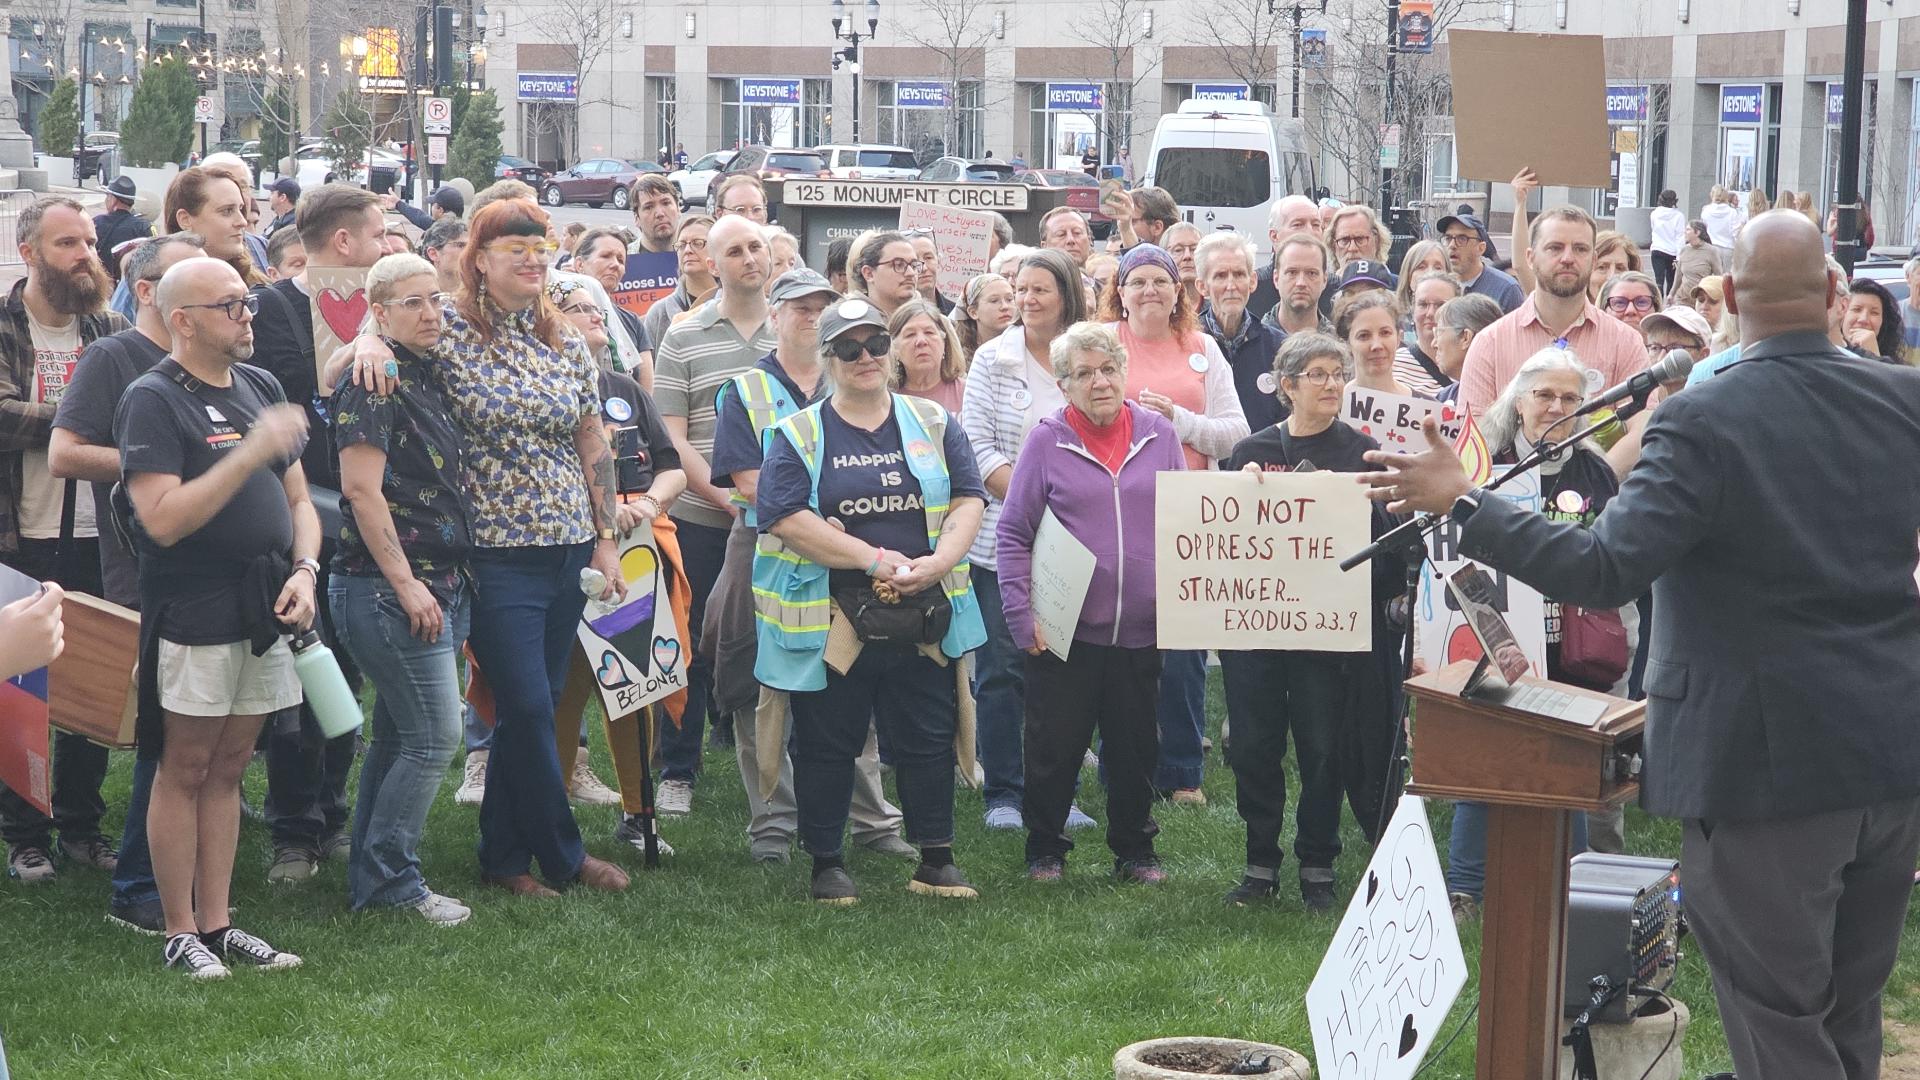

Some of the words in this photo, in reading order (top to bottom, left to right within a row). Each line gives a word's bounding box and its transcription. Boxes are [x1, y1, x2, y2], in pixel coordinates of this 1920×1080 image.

[520, 81, 566, 92] KEYSTONE
[744, 85, 789, 97] KEYSTONE
[899, 88, 943, 100] KEYSTONE
[1050, 90, 1092, 103] KEYSTONE
[1723, 95, 1756, 113] KEYSTONE
[1829, 95, 1844, 113] KEYS
[796, 185, 824, 201] 125
[834, 186, 939, 204] MONUMENT
[949, 189, 1015, 206] CIRCLE
[826, 227, 864, 237] CHRIST
[1356, 260, 1369, 274] B
[658, 275, 679, 287] Lov
[636, 292, 657, 303] ICE
[1350, 391, 1385, 424] We
[1386, 428, 1406, 443] to
[833, 450, 904, 469] HAPPIN
[880, 471, 902, 487] IS
[839, 493, 925, 516] COURA
[1201, 495, 1240, 524] DO
[1257, 498, 1316, 525] NOT
[1176, 533, 1274, 560] OPPRESS
[1288, 536, 1335, 560] THE
[1178, 577, 1300, 602] STRANGER...
[1225, 609, 1307, 632] EXODUS
[616, 671, 681, 711] BELONG
[1369, 888, 1415, 1032] LOVE
